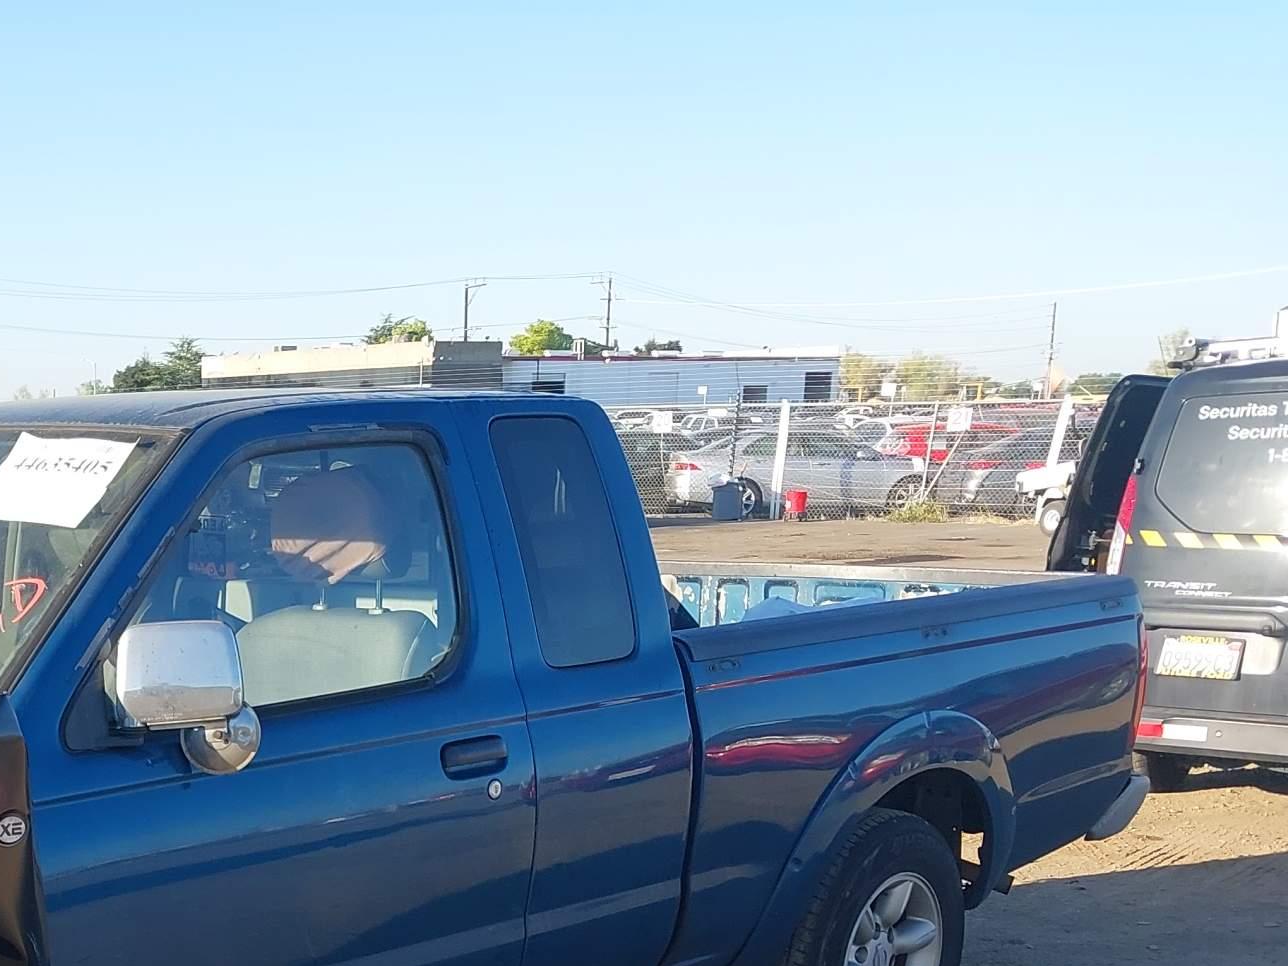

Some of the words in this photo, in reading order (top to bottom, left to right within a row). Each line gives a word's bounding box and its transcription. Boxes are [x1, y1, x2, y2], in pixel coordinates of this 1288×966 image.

[1198, 402, 1278, 420] Securitas
[13, 456, 114, 475] 44635405
[1144, 580, 1217, 591] TRANSIT
[1175, 589, 1233, 599] CONNECT
[0, 821, 23, 838] XE
